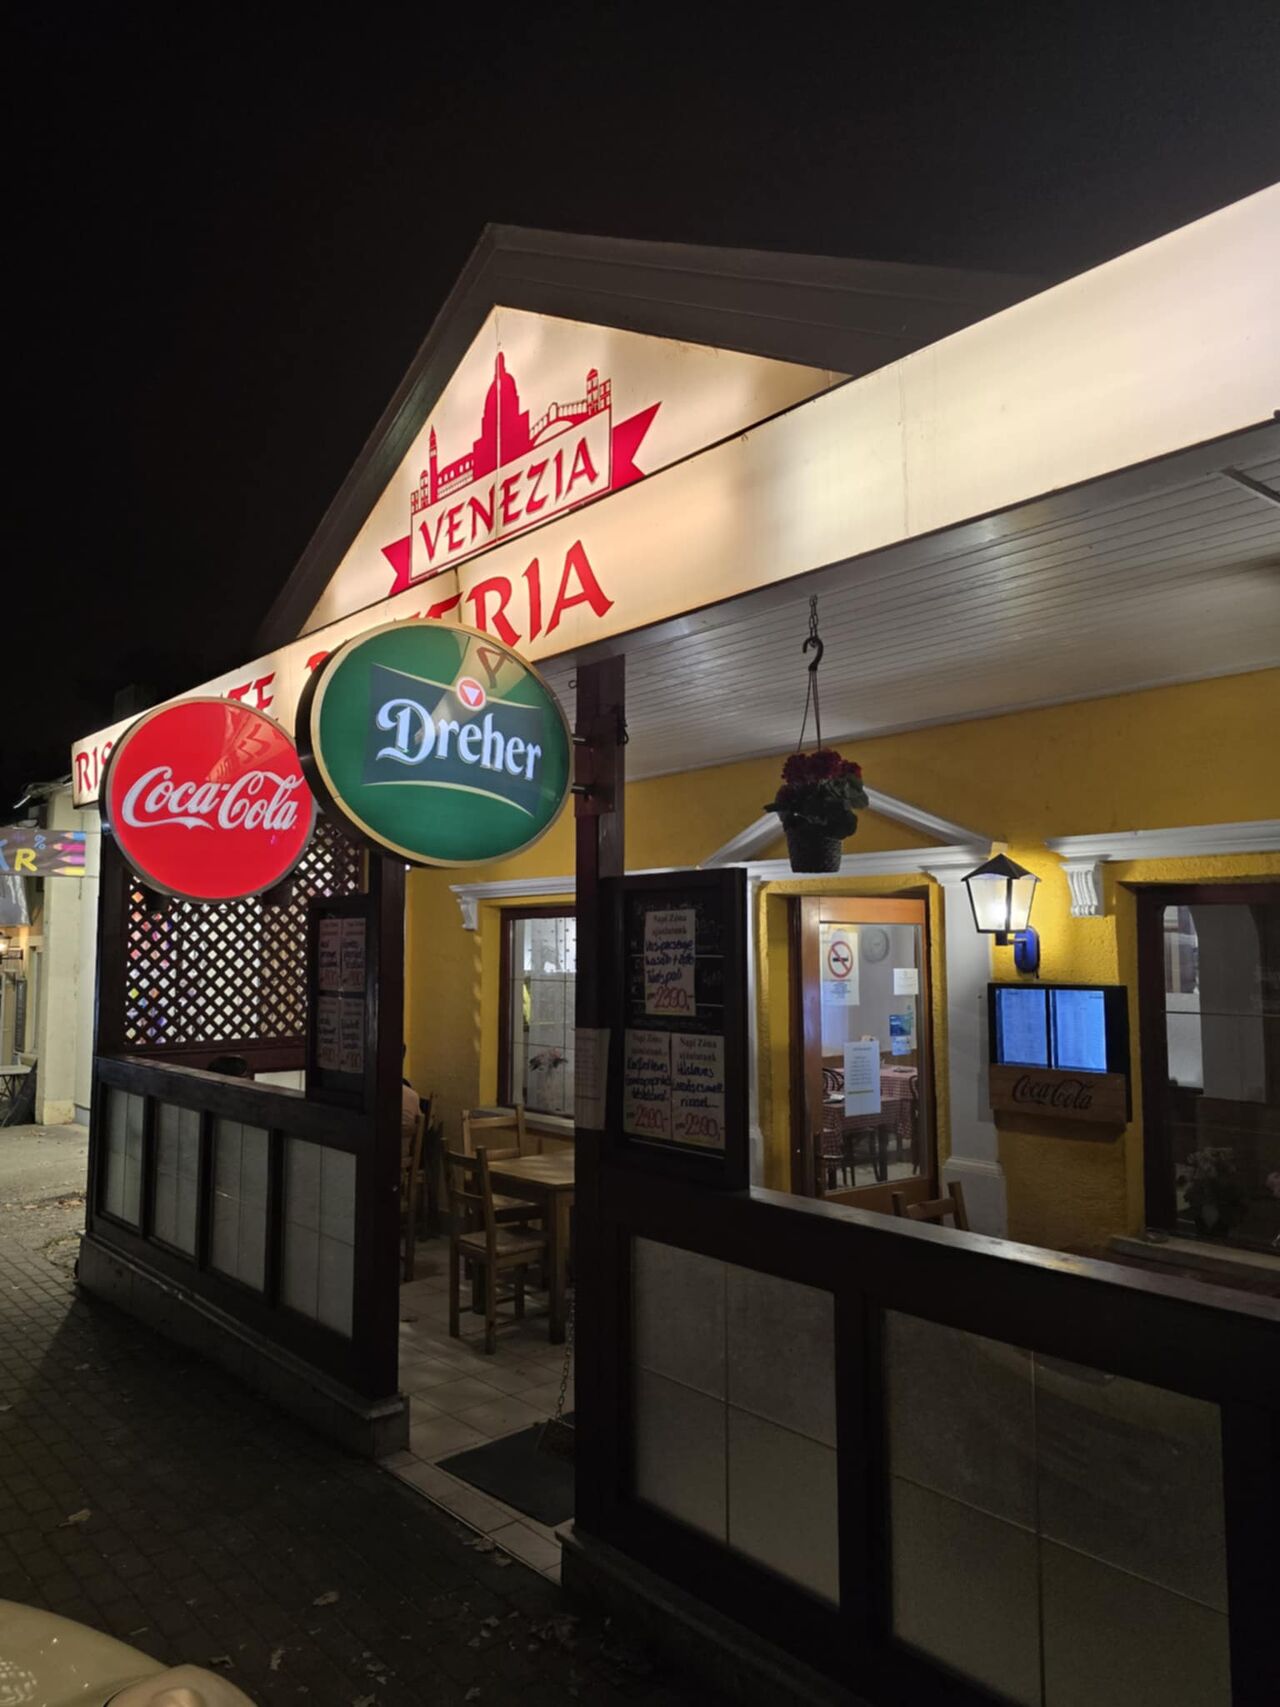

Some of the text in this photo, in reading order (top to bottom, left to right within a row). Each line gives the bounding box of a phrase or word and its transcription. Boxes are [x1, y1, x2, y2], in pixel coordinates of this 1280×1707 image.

[419, 436, 598, 562] VENEZIA
[375, 698, 542, 781] Dreher
[121, 766, 304, 830] Coca-Cola
